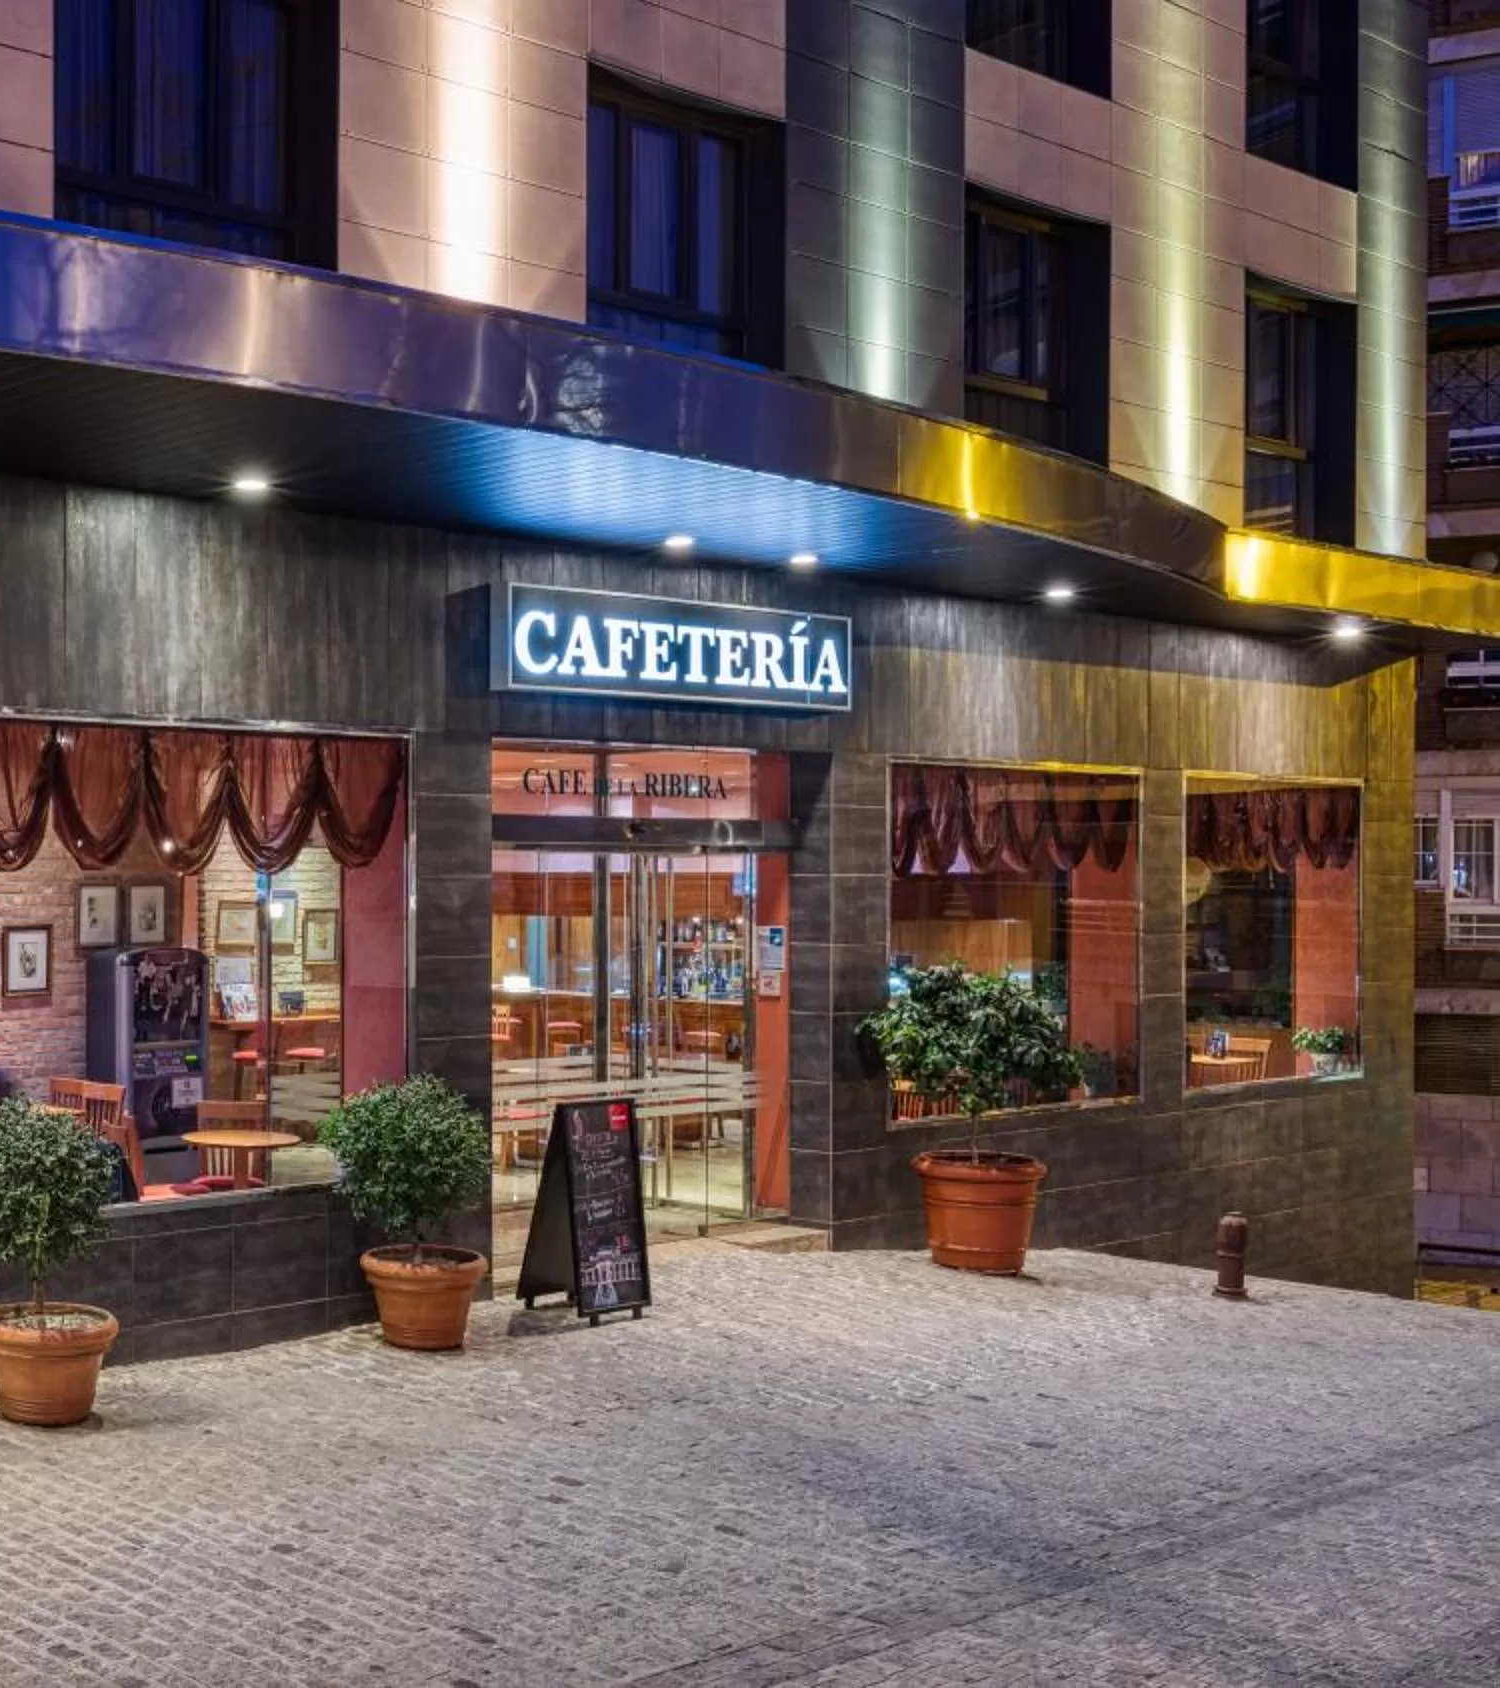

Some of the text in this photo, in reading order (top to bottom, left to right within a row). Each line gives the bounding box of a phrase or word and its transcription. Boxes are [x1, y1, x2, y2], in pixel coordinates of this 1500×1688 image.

[514, 610, 847, 693] CAFETERÍA
[523, 767, 587, 796] CAFE
[645, 773, 728, 800] RIBERA
